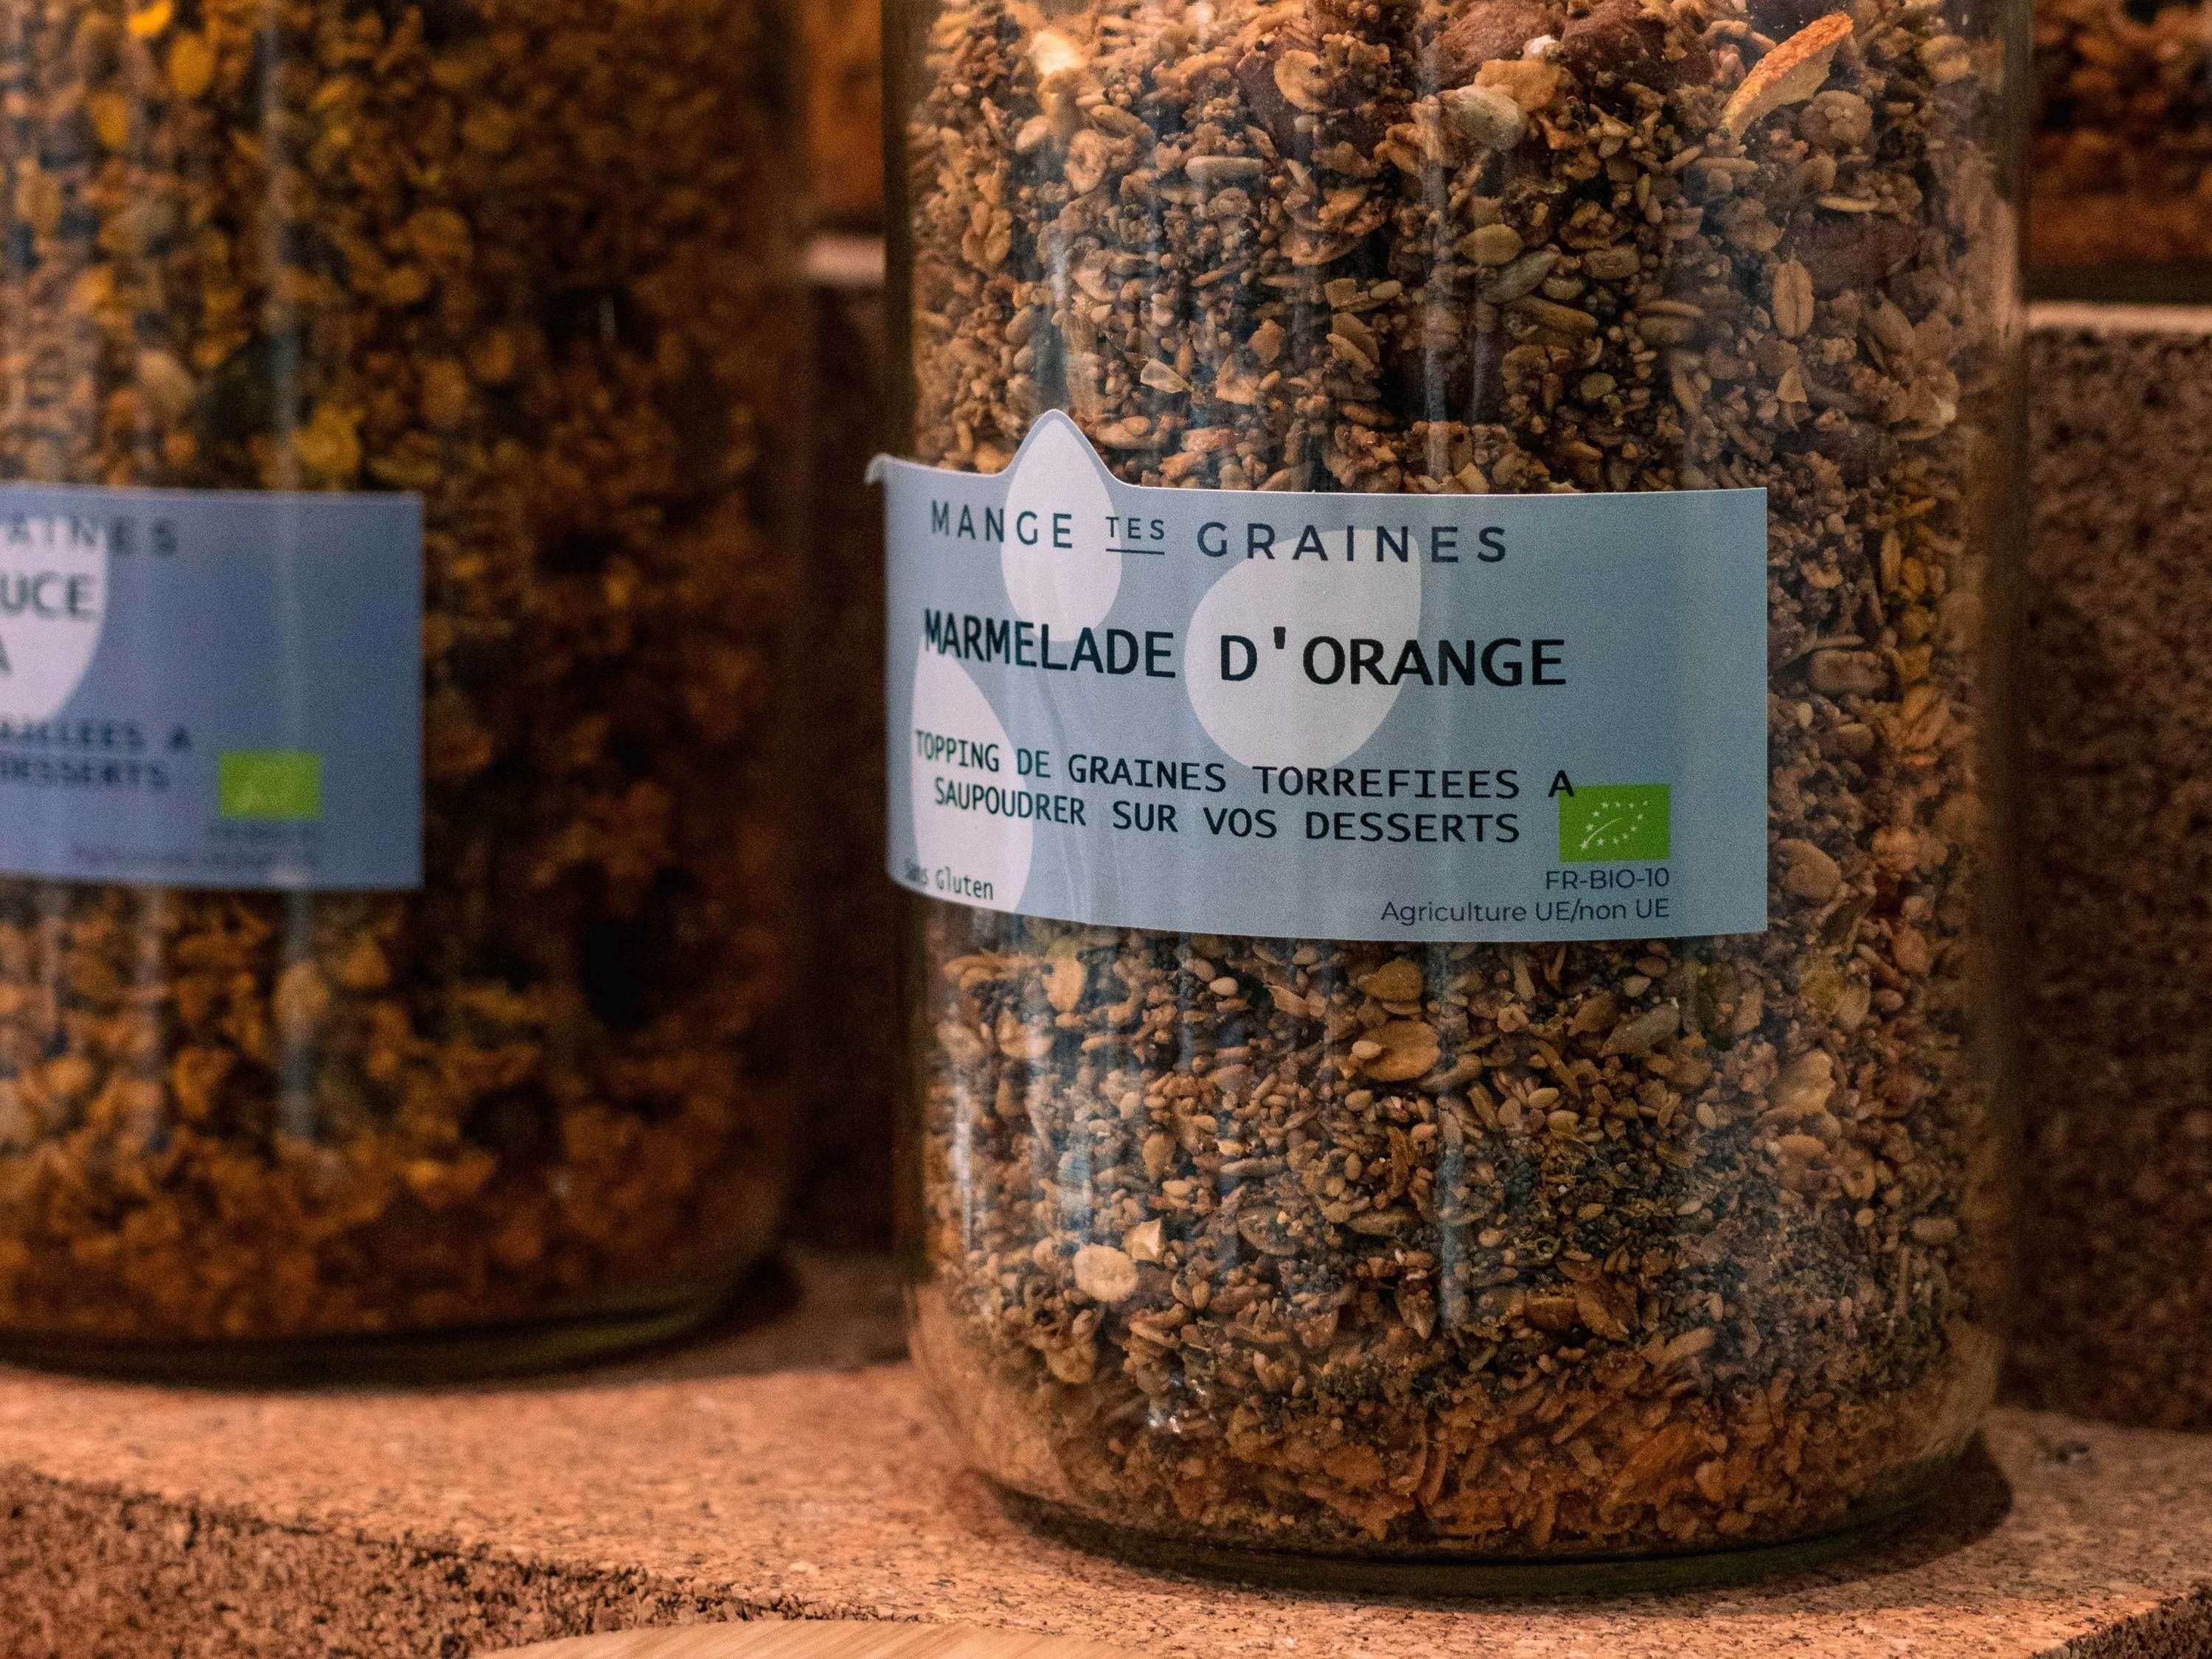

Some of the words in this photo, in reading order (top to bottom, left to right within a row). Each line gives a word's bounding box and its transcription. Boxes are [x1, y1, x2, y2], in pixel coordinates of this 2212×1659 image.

[931, 500, 1073, 549] MANGE
[1106, 517, 1165, 540] TES
[1197, 521, 1508, 563] GRAINES
[925, 608, 1176, 678] MARMELADE
[1220, 625, 1567, 686] D'ORANGE
[916, 730, 1000, 772] TOPPING
[1018, 748, 1051, 778] DE
[1068, 754, 1226, 793] GRAINES
[1253, 766, 1520, 799] TORREFIEES
[1548, 771, 1575, 797] A
[935, 777, 1086, 826] SAUPOUDRER
[1113, 801, 1178, 832] SUR
[1203, 807, 1277, 839] VOS
[1306, 812, 1520, 843] DESSERTS
[936, 866, 993, 900] Gluten
[1546, 868, 1670, 890] FR-BIO-10
[1380, 900, 1527, 926] Agriculture
[1536, 898, 1627, 923] UE/non
[1636, 898, 1669, 919] UE
